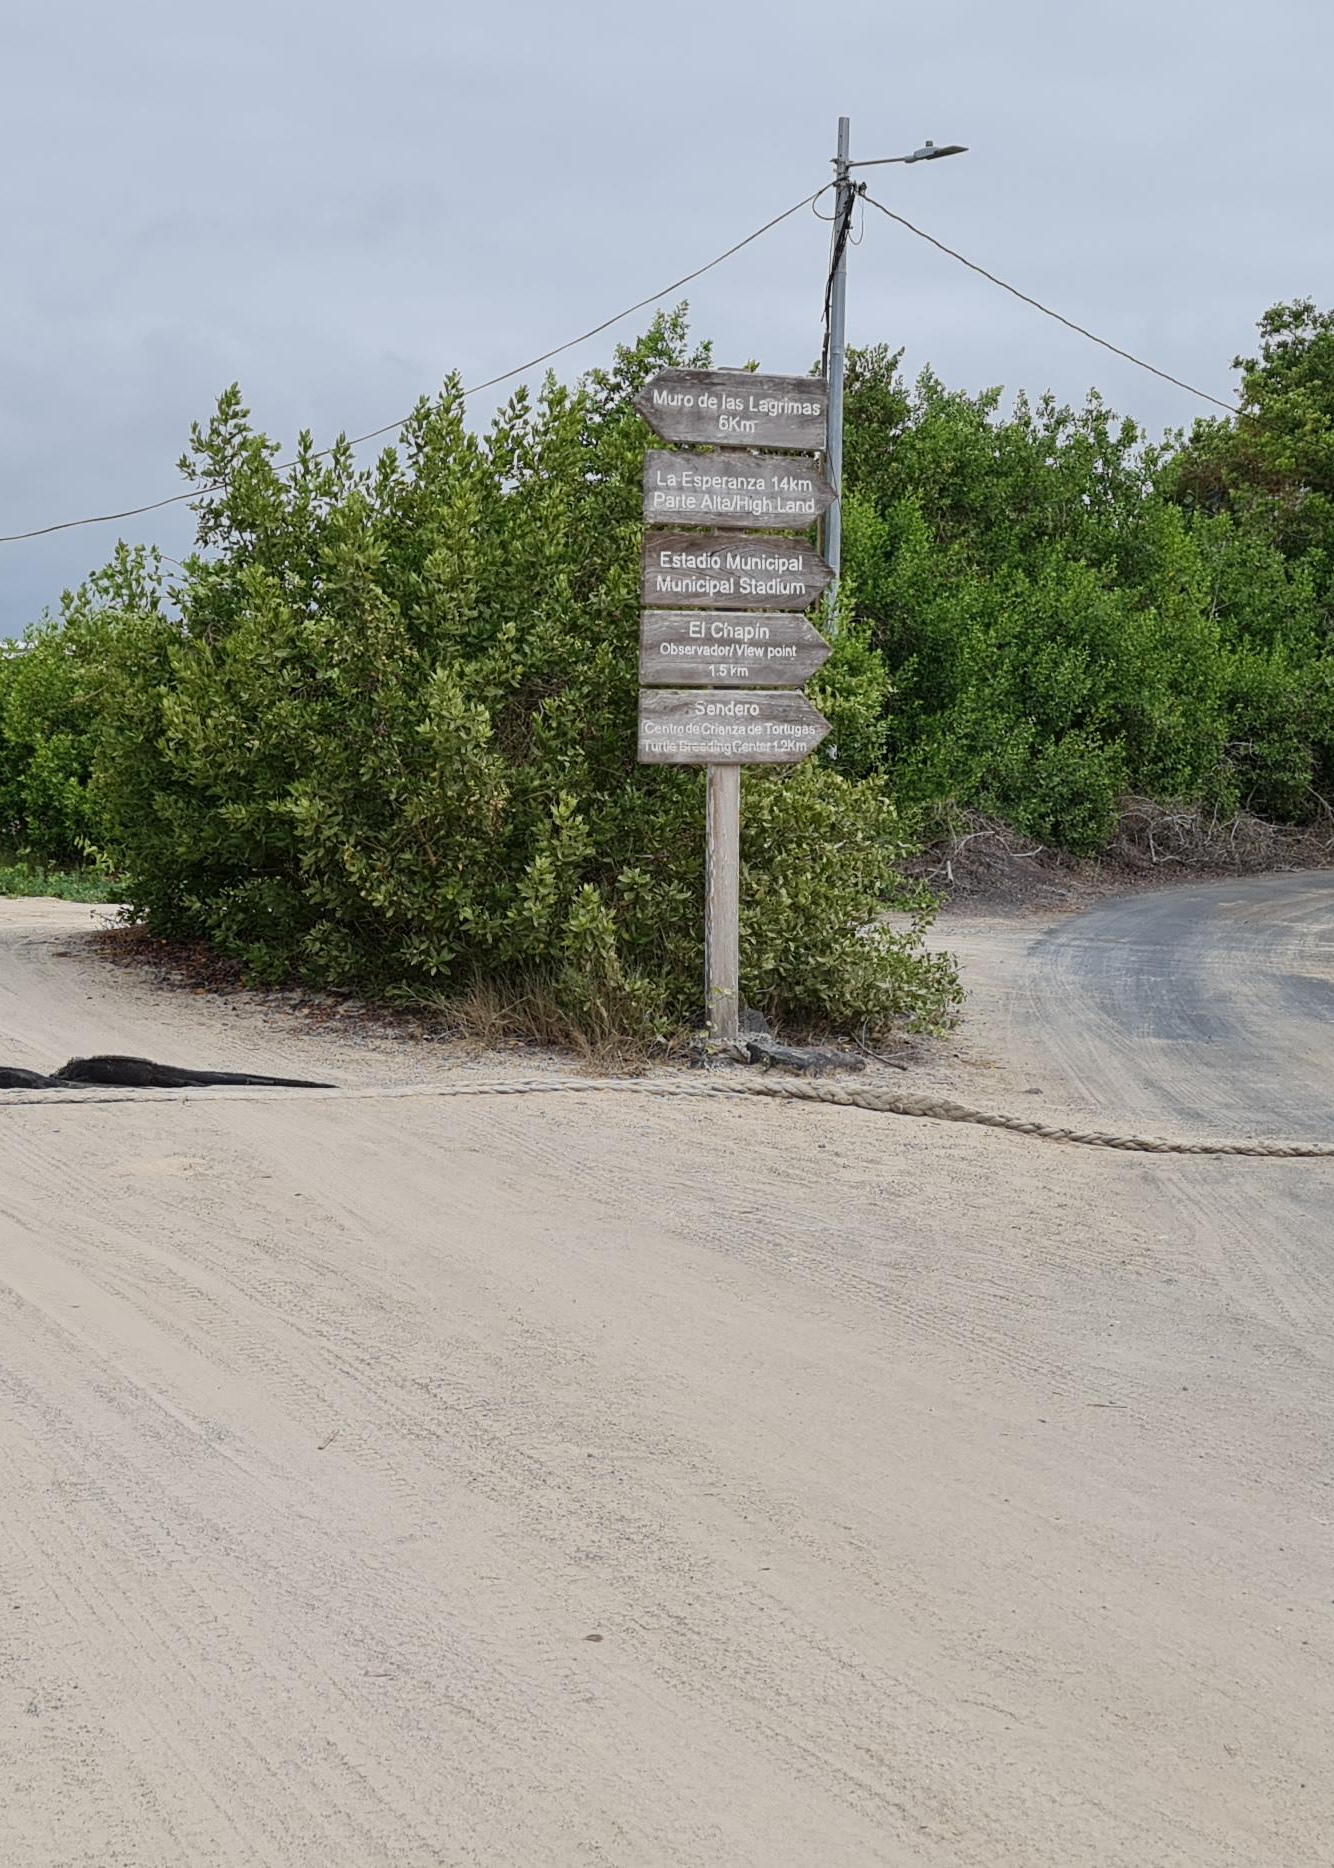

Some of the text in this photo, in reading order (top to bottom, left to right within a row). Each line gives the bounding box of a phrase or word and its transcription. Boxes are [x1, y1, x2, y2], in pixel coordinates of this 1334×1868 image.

[652, 389, 821, 416] Muro de las Lagrimas
[657, 471, 812, 492] La Esperanza 14km
[653, 492, 815, 515] Parte Alta/High Land
[660, 552, 803, 573] Estadio Municipal
[656, 576, 806, 595] Municipal Stadium
[689, 621, 705, 638] El
[768, 645, 797, 659] point
[709, 664, 749, 677] 1.5 km
[695, 701, 759, 716] Sendero
[644, 722, 816, 737] Centro de Crianza de Tortugas
[643, 739, 678, 752] Turtle
[732, 741, 771, 752] Center
